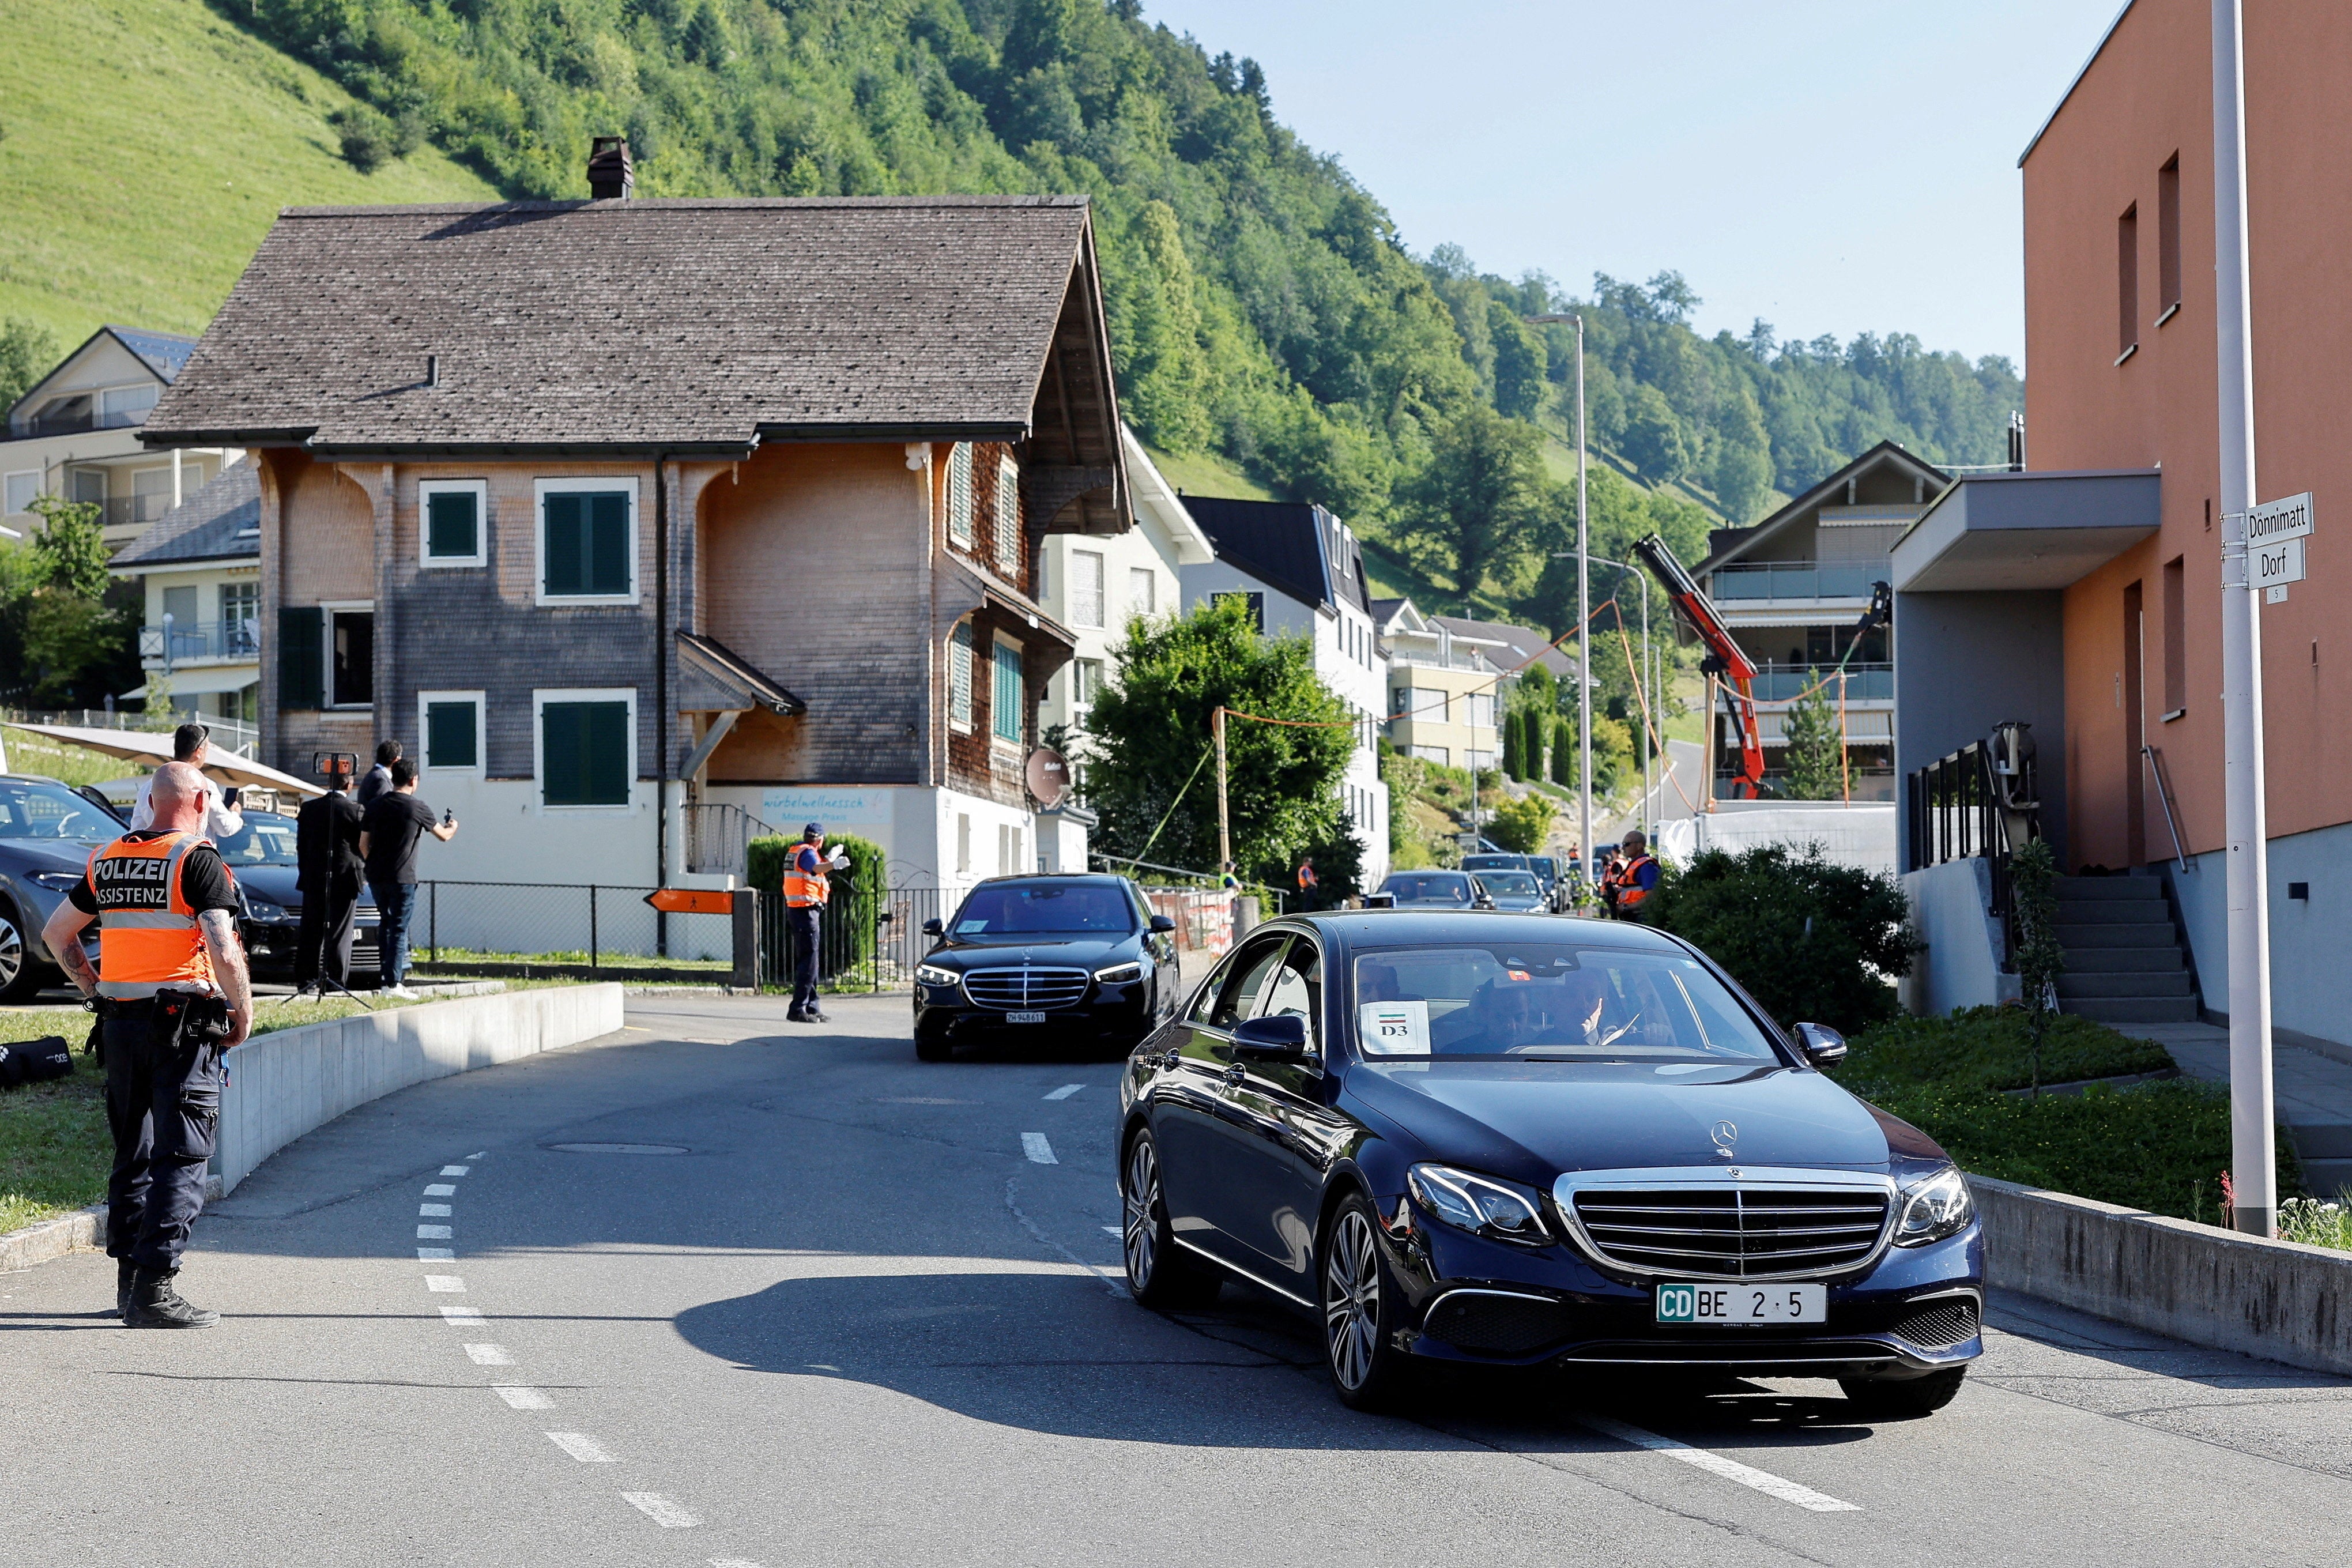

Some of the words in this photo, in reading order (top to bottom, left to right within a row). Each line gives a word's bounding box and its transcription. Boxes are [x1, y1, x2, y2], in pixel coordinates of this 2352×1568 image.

[2249, 503, 2306, 538] Dönnimatt
[2261, 547, 2286, 577] Dorf
[2275, 589, 2278, 598] 5
[95, 859, 167, 882] POLIZEI
[96, 887, 166, 904] ASSISTENZ
[1381, 1026, 1408, 1036] D3
[54, 1053, 68, 1063] ace
[1661, 1290, 1691, 1317] CD
[1698, 1291, 1728, 1317] BE
